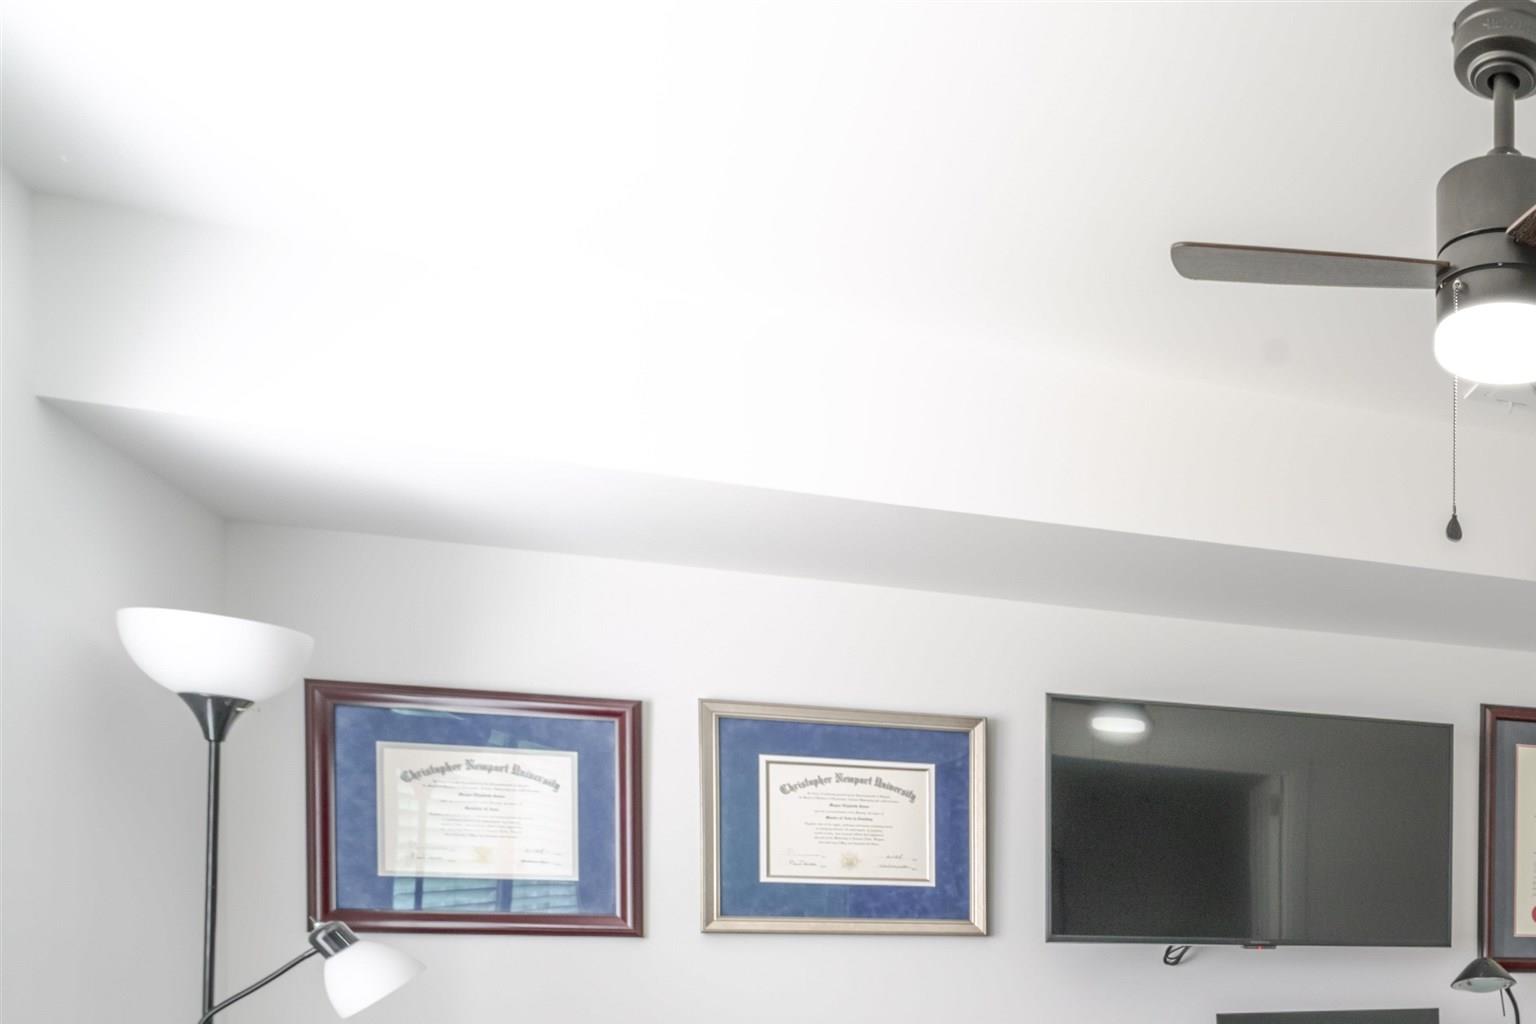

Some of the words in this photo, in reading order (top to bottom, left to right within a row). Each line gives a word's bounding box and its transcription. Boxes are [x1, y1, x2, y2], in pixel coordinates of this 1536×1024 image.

[400, 761, 462, 783] Christopher
[465, 759, 509, 774] Newport
[511, 763, 560, 792] University
[779, 774, 832, 795] Christopher
[835, 772, 873, 786] Newport
[874, 776, 917, 803] University
